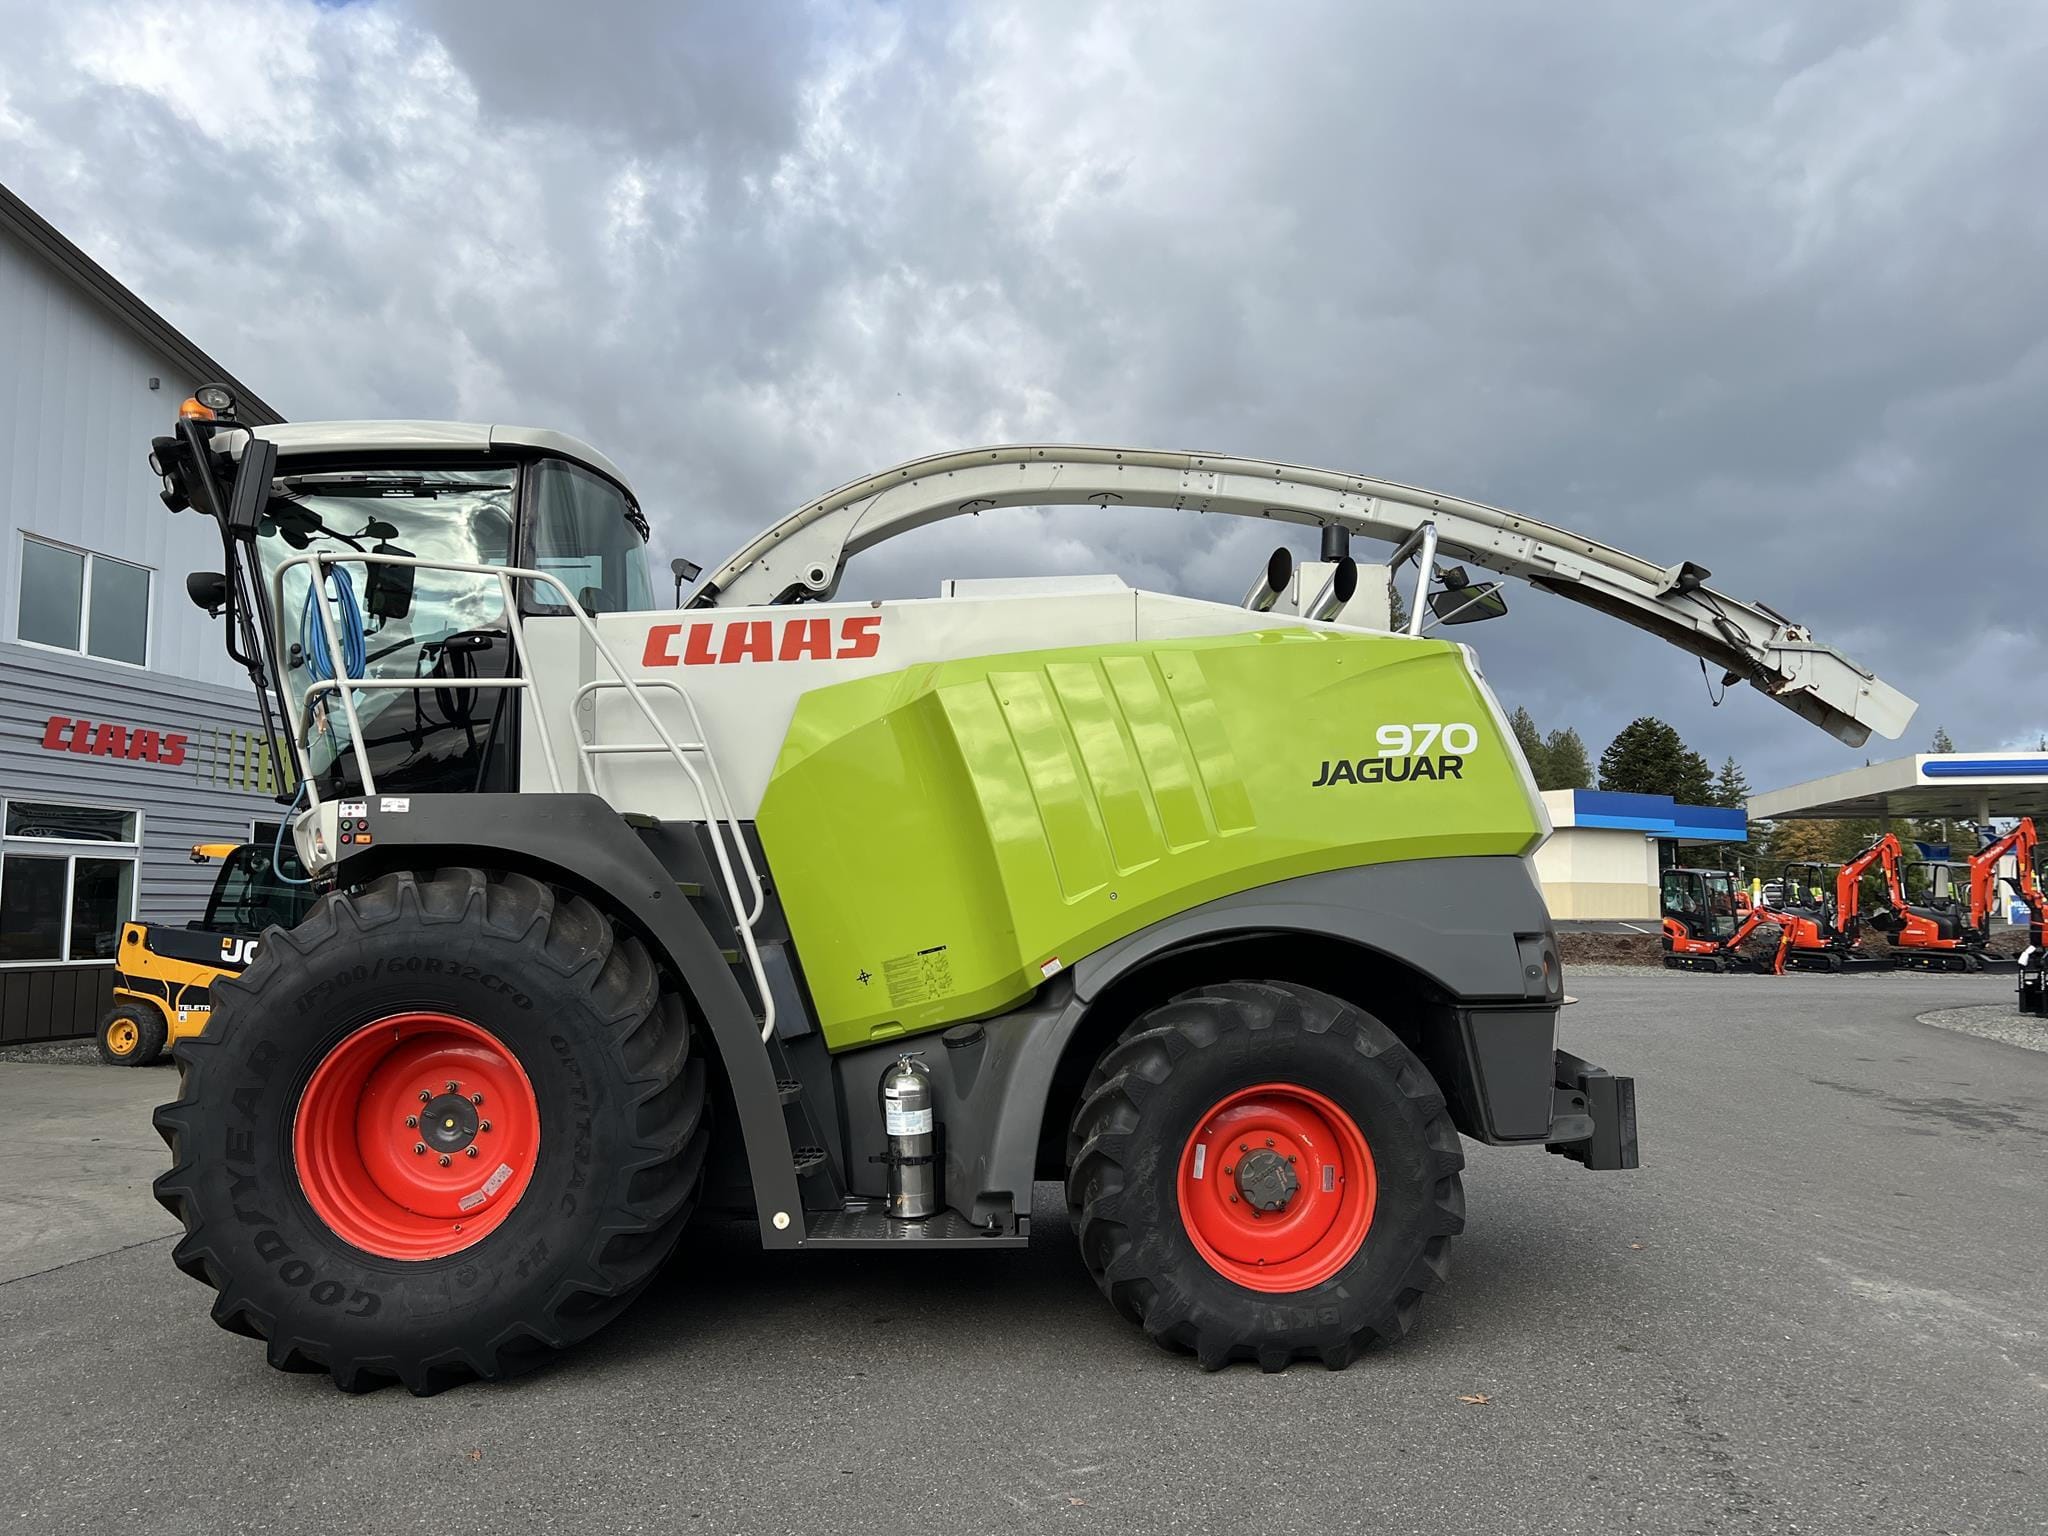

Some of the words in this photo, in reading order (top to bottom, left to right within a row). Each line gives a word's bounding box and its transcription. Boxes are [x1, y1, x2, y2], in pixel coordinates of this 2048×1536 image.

[641, 616, 882, 668] CLAAS
[41, 716, 188, 766] CLAAS
[1376, 722, 1478, 758] 970
[1312, 755, 1463, 787] JAGUAR
[221, 938, 259, 965] JC
[225, 1040, 382, 1318] GOODYEAR
